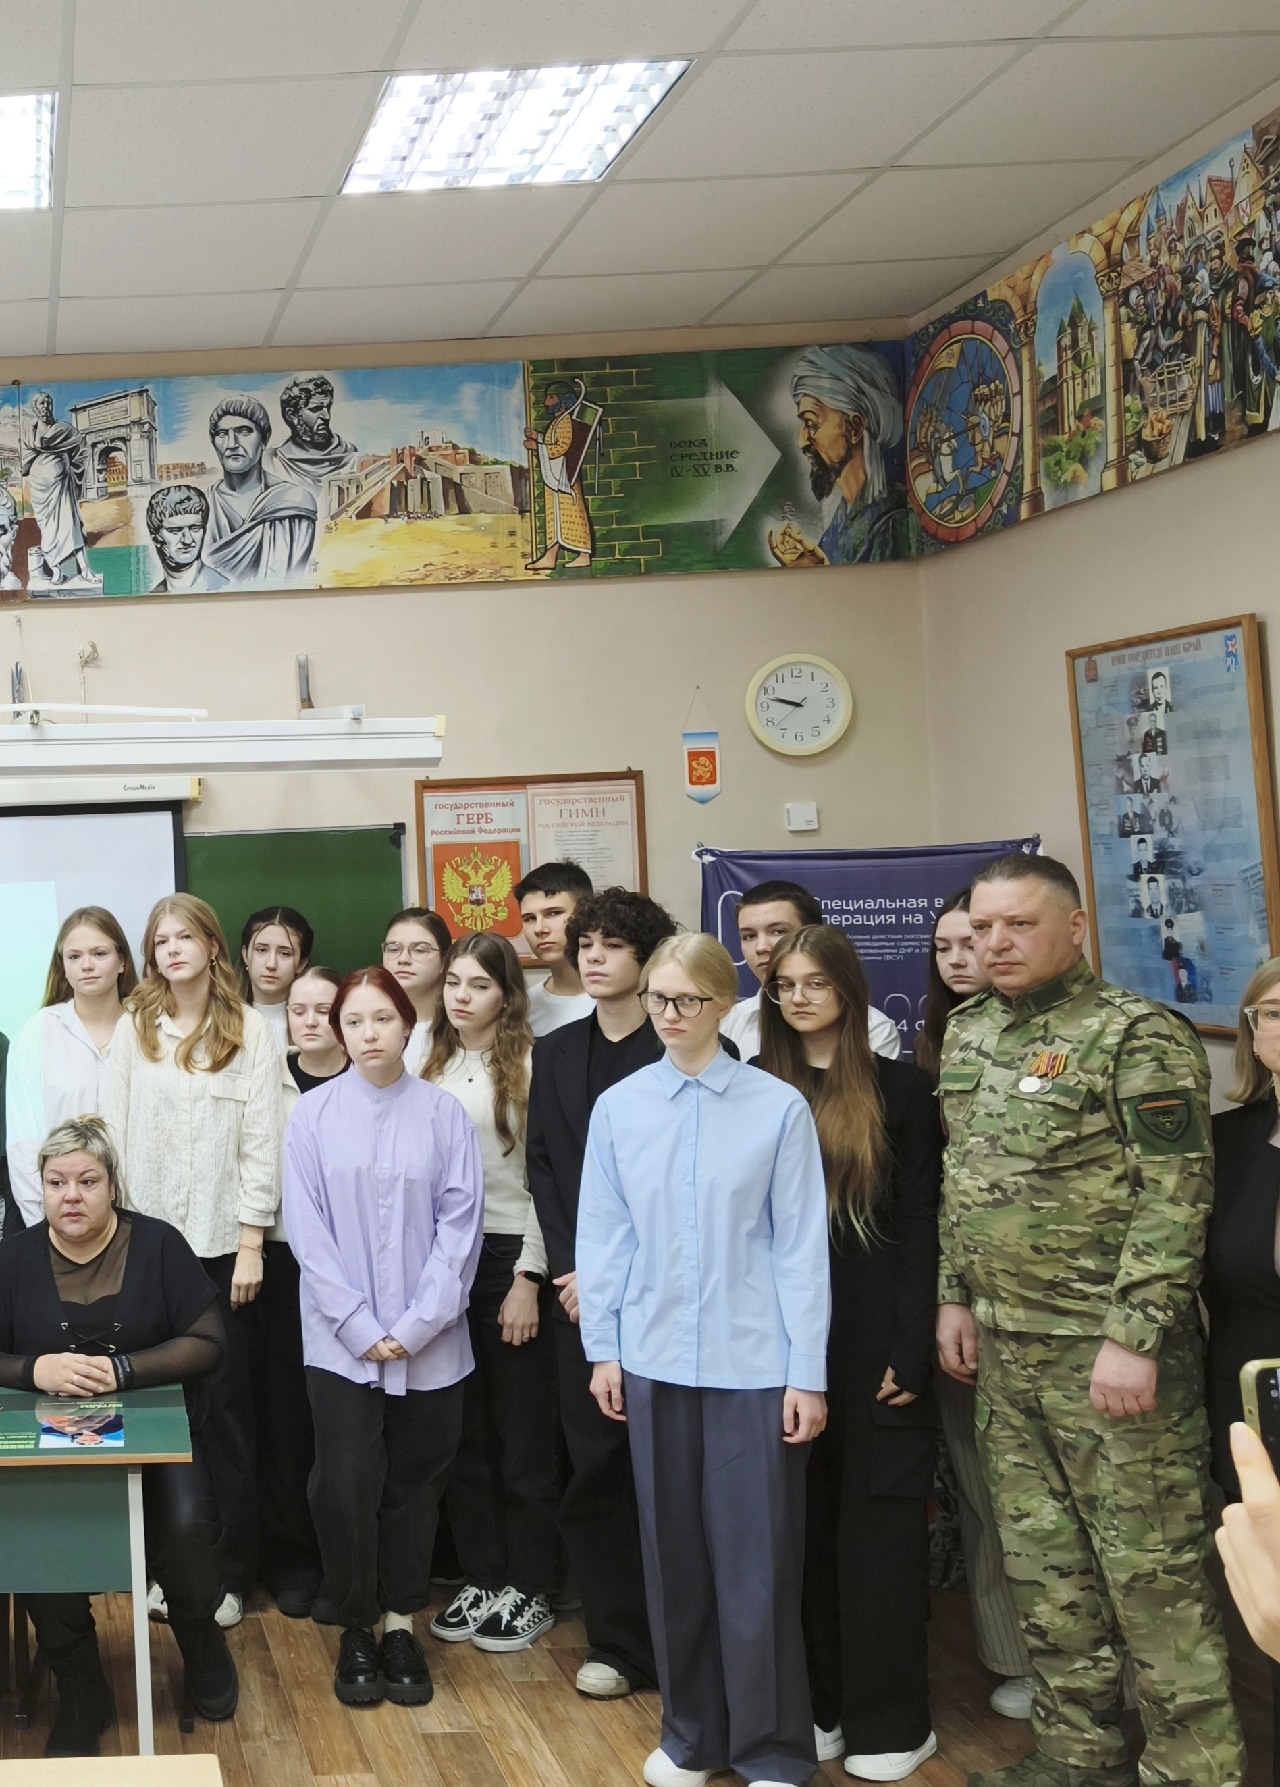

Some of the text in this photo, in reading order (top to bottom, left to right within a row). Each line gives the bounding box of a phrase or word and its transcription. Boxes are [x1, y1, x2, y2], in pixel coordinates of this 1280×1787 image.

[775, 673, 785, 683] 11
[790, 667, 802, 678] 12
[763, 686, 775, 696] 10
[820, 682, 829, 692] 2
[760, 701, 770, 712] 9
[825, 698, 835, 708] 3
[765, 717, 775, 727] 8
[822, 714, 831, 724] 4
[779, 728, 788, 739] 7
[794, 731, 804, 742] 6
[810, 726, 821, 737] 5
[434, 799, 515, 811] государственный
[559, 807, 606, 818] ГИМН
[455, 812, 494, 825] ГЕРБ
[814, 896, 928, 911] пециальная
[821, 913, 896, 927] перация
[902, 913, 923, 924] на
